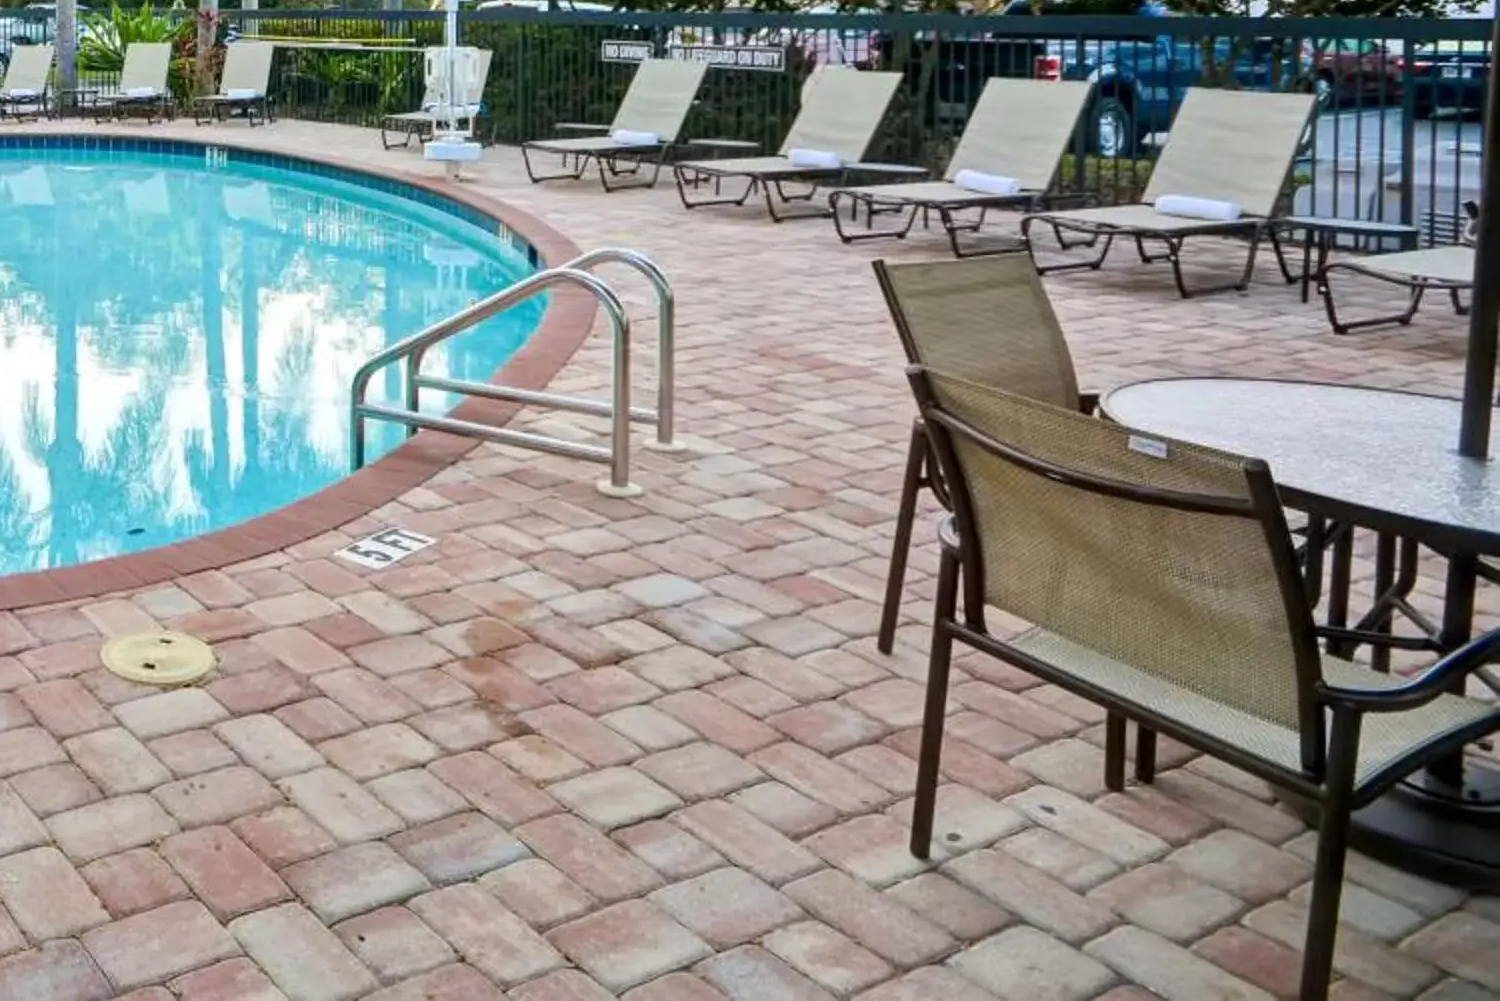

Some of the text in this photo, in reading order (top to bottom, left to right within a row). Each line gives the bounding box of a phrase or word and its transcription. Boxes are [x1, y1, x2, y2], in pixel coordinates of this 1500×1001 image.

[605, 44, 649, 59] NO DIVING
[738, 51, 752, 65] ON
[754, 52, 781, 67] DUTY
[345, 528, 430, 562] 5 FT
